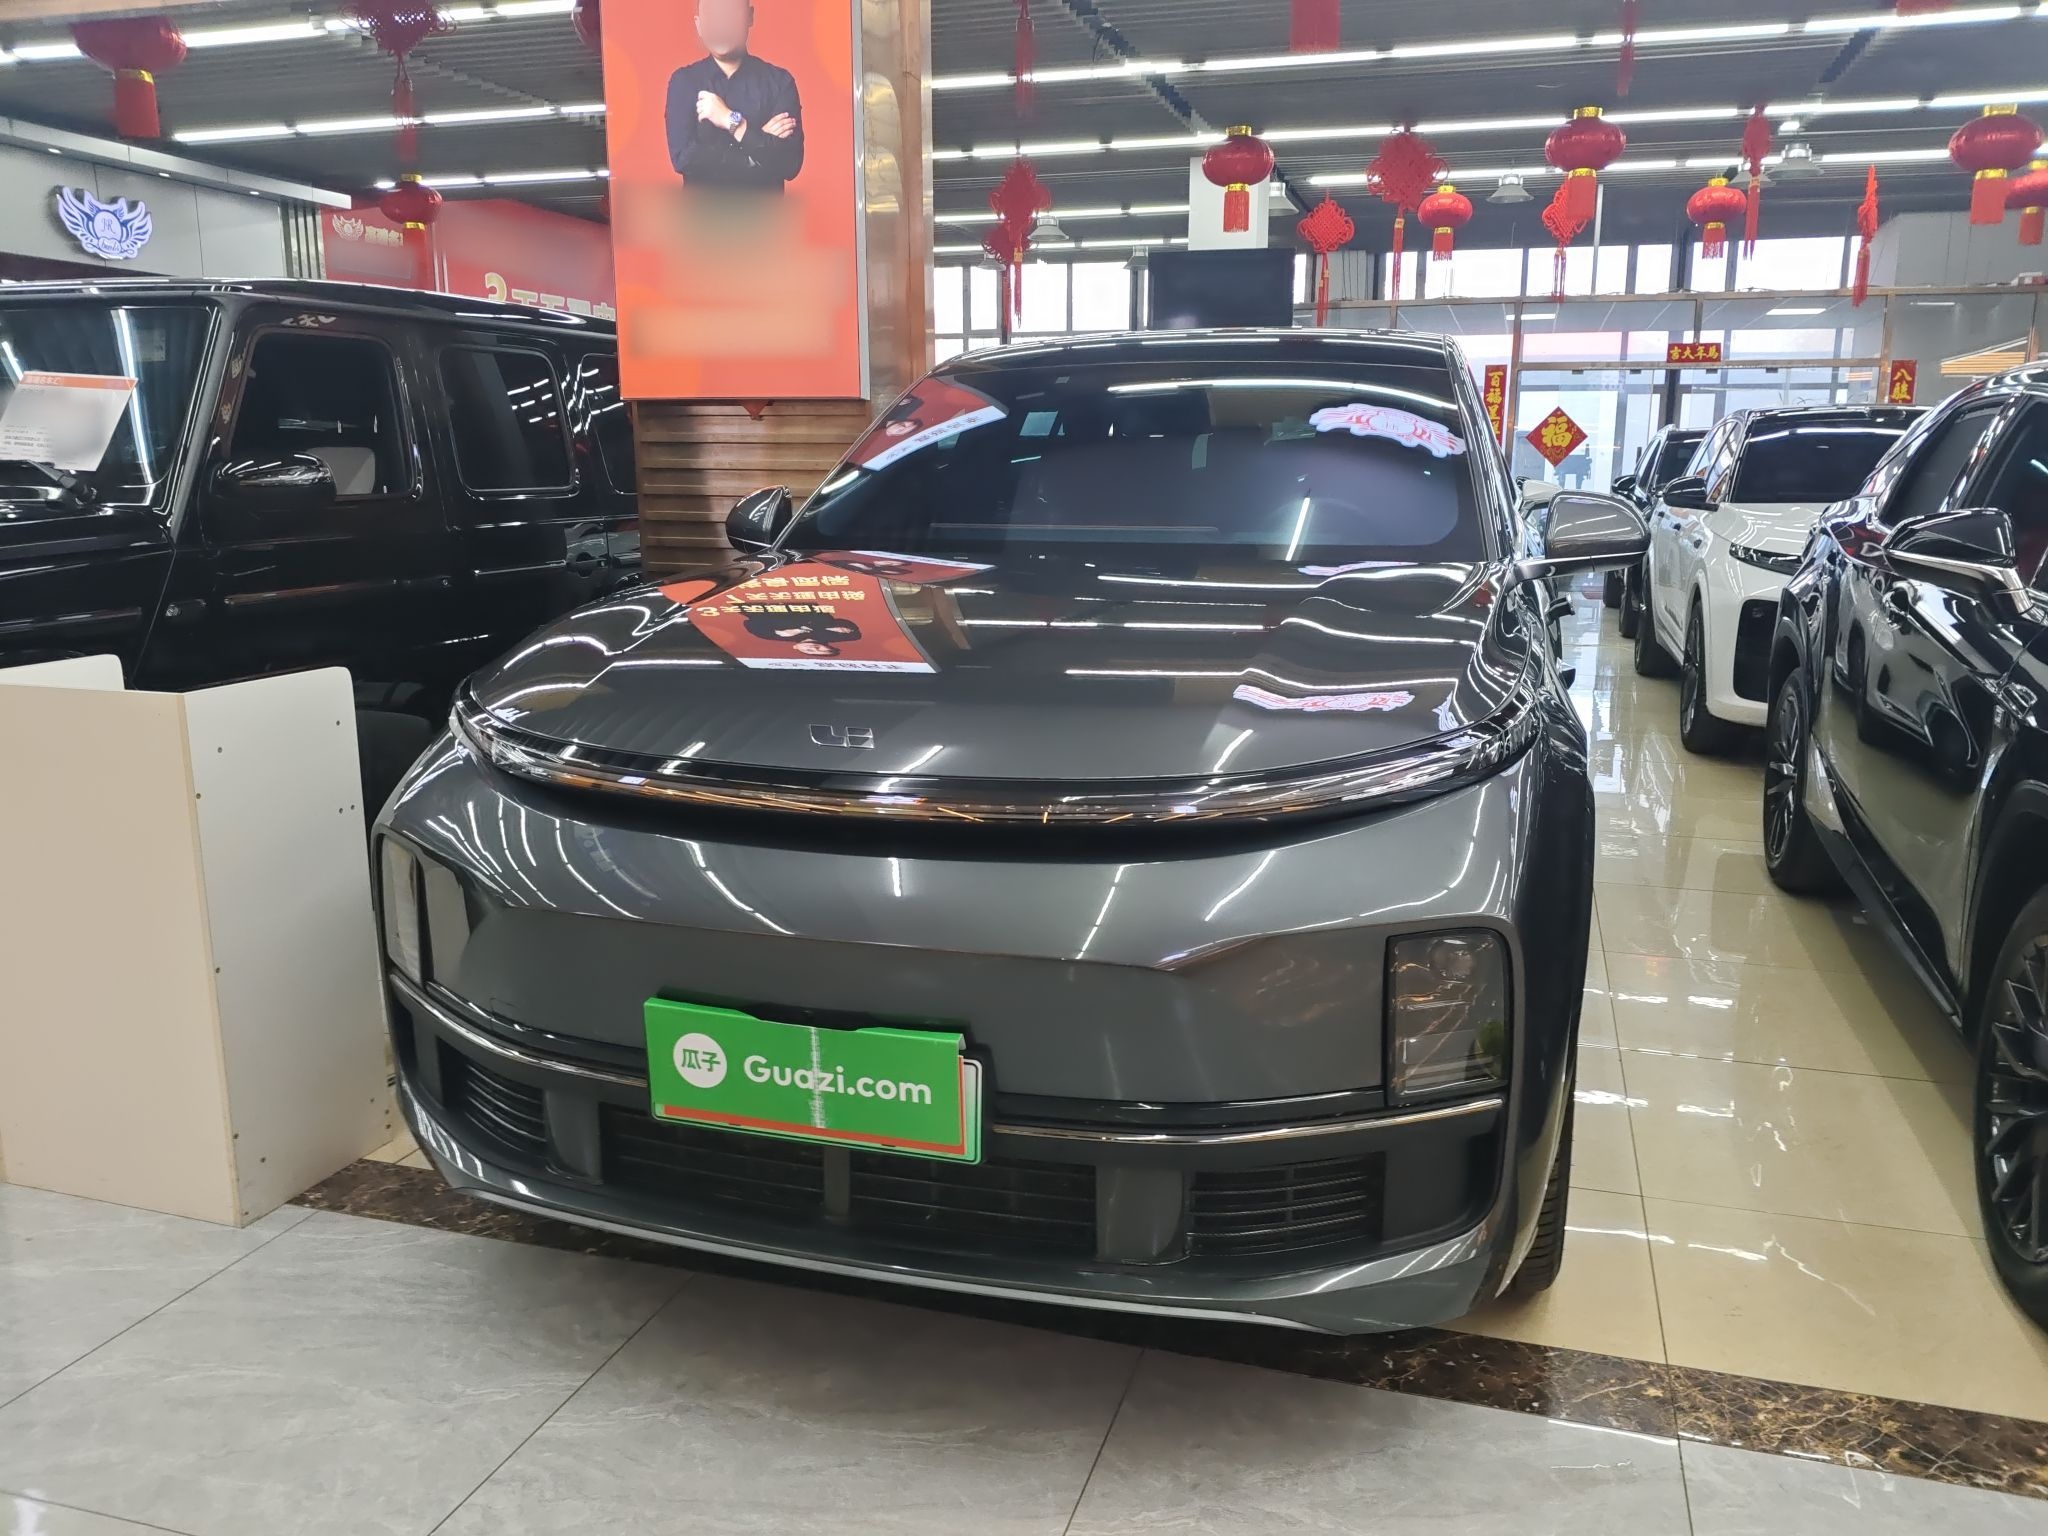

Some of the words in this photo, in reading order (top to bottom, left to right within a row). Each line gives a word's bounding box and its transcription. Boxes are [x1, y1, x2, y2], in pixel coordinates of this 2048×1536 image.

[1541, 416, 1573, 448] 福
[681, 1048, 721, 1072] 瓜子
[744, 1055, 932, 1104] Guazi.com
